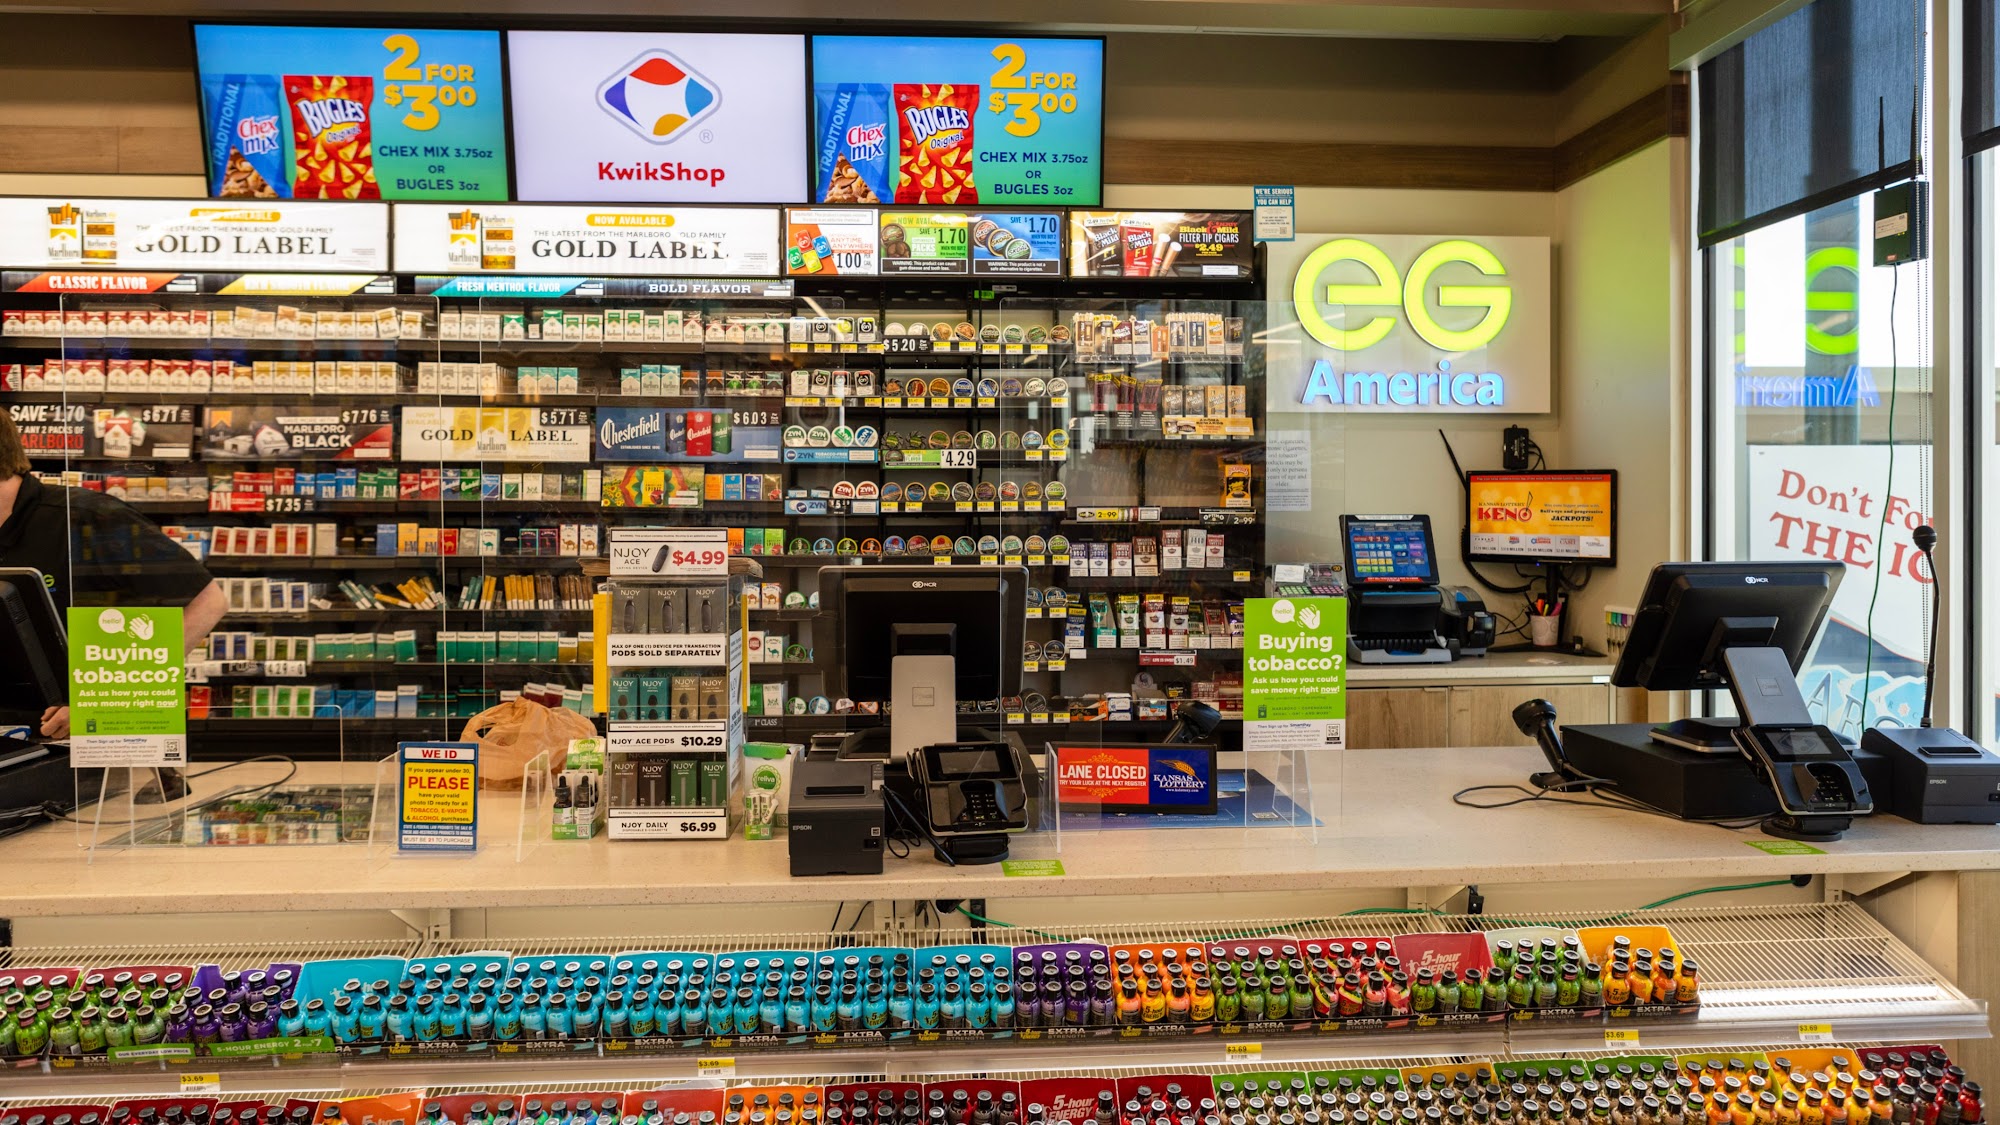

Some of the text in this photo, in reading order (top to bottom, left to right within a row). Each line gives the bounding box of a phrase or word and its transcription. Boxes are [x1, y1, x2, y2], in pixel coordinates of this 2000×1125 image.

[382, 34, 475, 82] 2 FOR
[991, 43, 1076, 89] 2 FOR
[214, 83, 240, 165] TRADITIONAL
[297, 99, 365, 137] BUGLES
[905, 106, 969, 144] BUGLES
[239, 116, 278, 138] Chex
[820, 92, 851, 173] TRADITIONAL
[848, 123, 886, 145] Chex
[245, 136, 278, 155] mix
[379, 146, 492, 158] CHEX MIX 3.75oz
[851, 140, 884, 161] mix
[980, 152, 1088, 163] CHEX MIX 3.75oz
[428, 165, 445, 173] OR
[598, 162, 725, 187] KwikShop
[397, 179, 479, 190] BUGLES 3oz
[995, 184, 1073, 195] BUGLES 3oz
[594, 216, 666, 225] NOW AVAILABLE
[1094, 228, 1117, 242] Black
[1127, 231, 1151, 242] Black
[1179, 233, 1239, 243] FILTER TIP CIGARS
[234, 236, 336, 254] LABEL
[532, 240, 729, 259] GOLD LABEL
[1195, 244, 1223, 252] $2.49
[1135, 249, 1147, 257] FT
[48, 276, 148, 290] CLASSIC FLAVOR
[457, 282, 560, 292] FRESH MENTHOL FLAVOR
[649, 284, 751, 294] BOLD FLAVOR
[883, 338, 916, 352] $5.20
[1301, 359, 1505, 406] America
[541, 412, 574, 425] $5.71
[733, 412, 767, 425] $6.03
[284, 425, 346, 433] MARLBORO
[421, 429, 573, 442] GOLD LABEL
[601, 412, 660, 449] Chesterfield
[812, 430, 826, 438] ZYN
[292, 435, 352, 448] BLACK
[1777, 469, 1873, 518] Don't
[1477, 508, 1532, 522] KENO
[1770, 511, 1874, 570] THE
[614, 548, 650, 558] NJOY
[672, 550, 725, 566] $4.99
[1259, 632, 1332, 653] Buying
[85, 643, 168, 665] Buying
[1248, 655, 1343, 671] tobacco?
[73, 667, 180, 684] tobacco?
[1300, 677, 1314, 685] you
[133, 690, 149, 698] you
[152, 689, 176, 697] could
[1300, 686, 1319, 694] right
[133, 700, 154, 708] right
[681, 737, 722, 747] $10.29
[422, 750, 457, 758] WE ID
[1059, 765, 1146, 779] LANE CLOSED
[408, 776, 469, 790] PLEASE
[680, 822, 716, 832] $6.99
[1421, 950, 1461, 966] 5-hour
[1053, 1095, 1095, 1111] 5-hour
